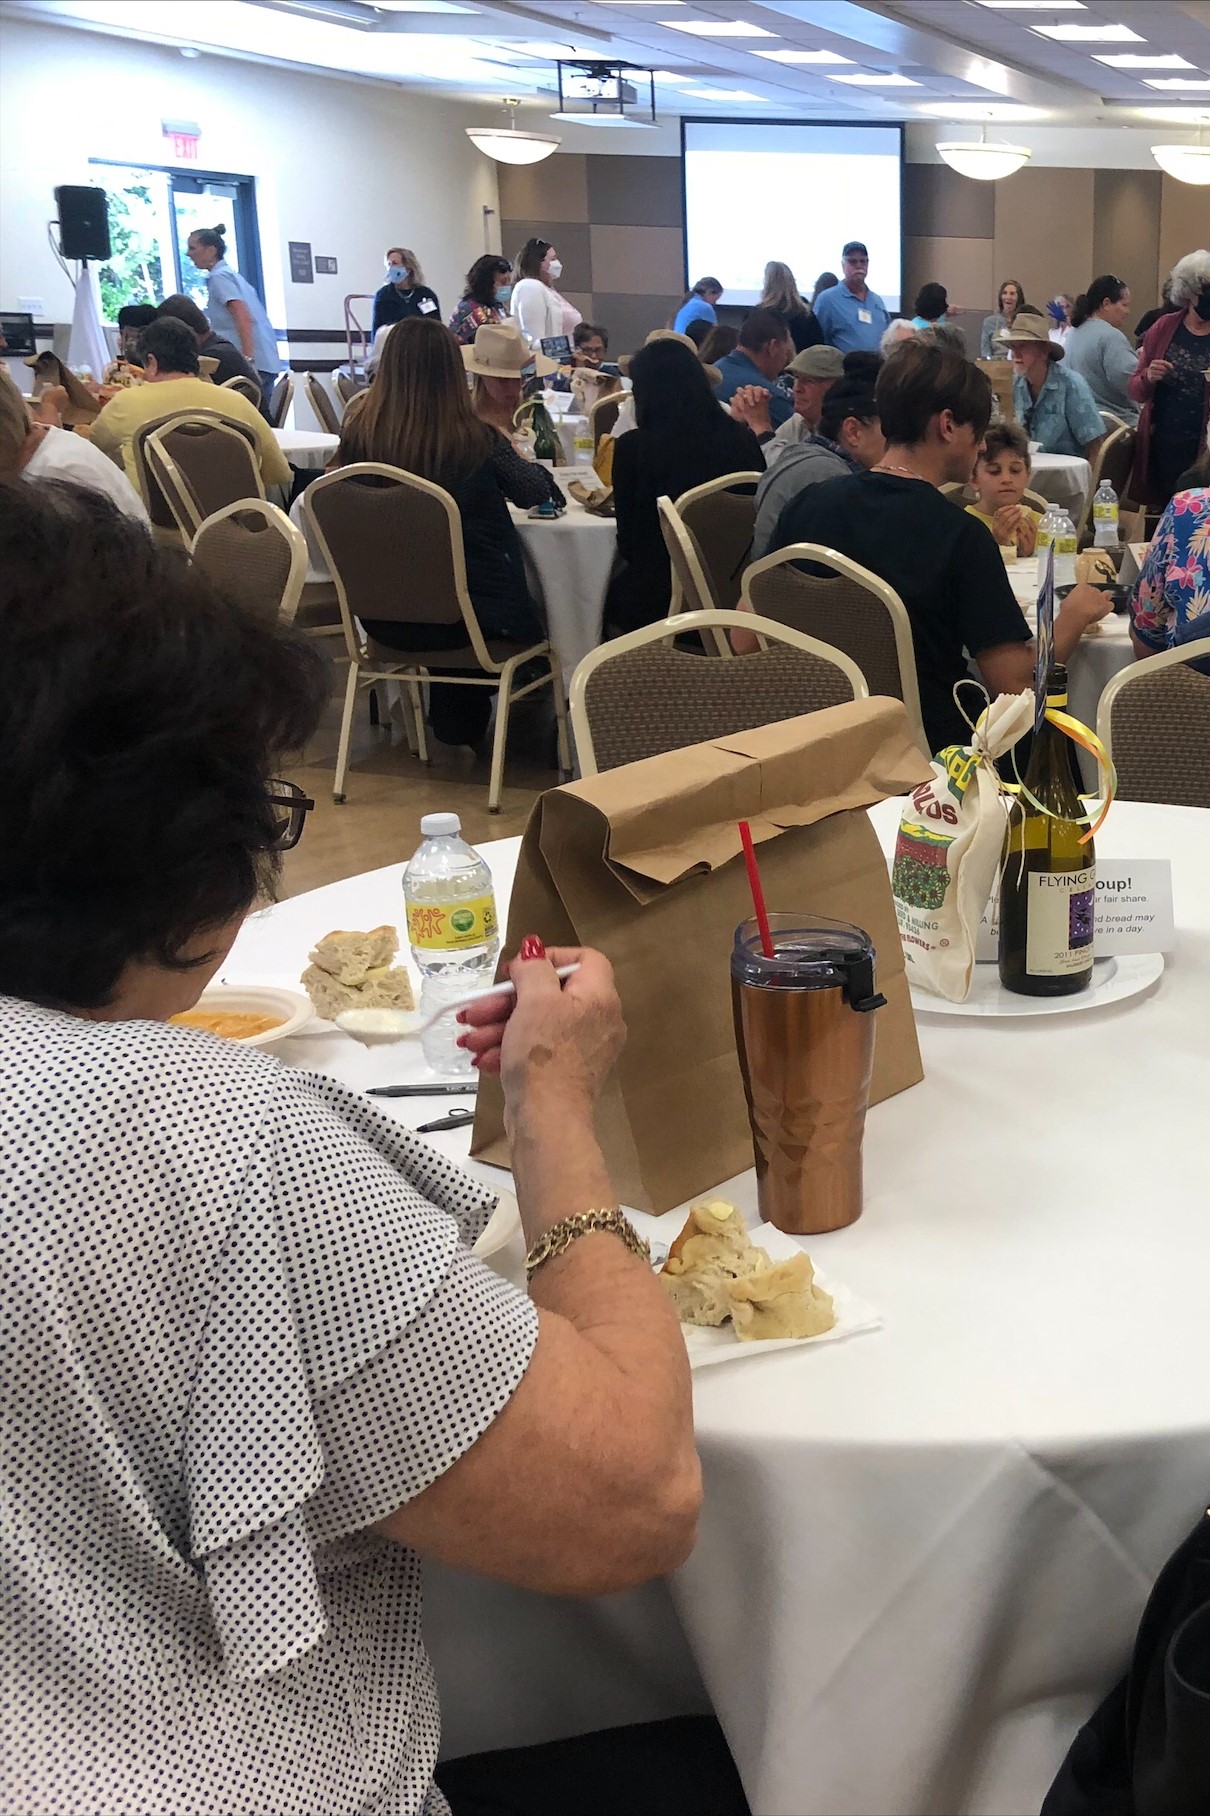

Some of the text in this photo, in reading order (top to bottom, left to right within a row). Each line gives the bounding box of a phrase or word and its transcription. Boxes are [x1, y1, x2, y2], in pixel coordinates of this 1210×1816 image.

[175, 136, 198, 159] EXIT
[1039, 872, 1087, 887] FLYING
[1095, 877, 1132, 892] oup!
[1104, 894, 1118, 903] fair
[1121, 894, 1149, 903] share.
[980, 916, 988, 924] A
[1105, 914, 1132, 922] bread
[1135, 914, 1155, 923] may
[1105, 925, 1115, 933] in
[1125, 925, 1145, 935] day.
[906, 934, 930, 951] FLOWERS
